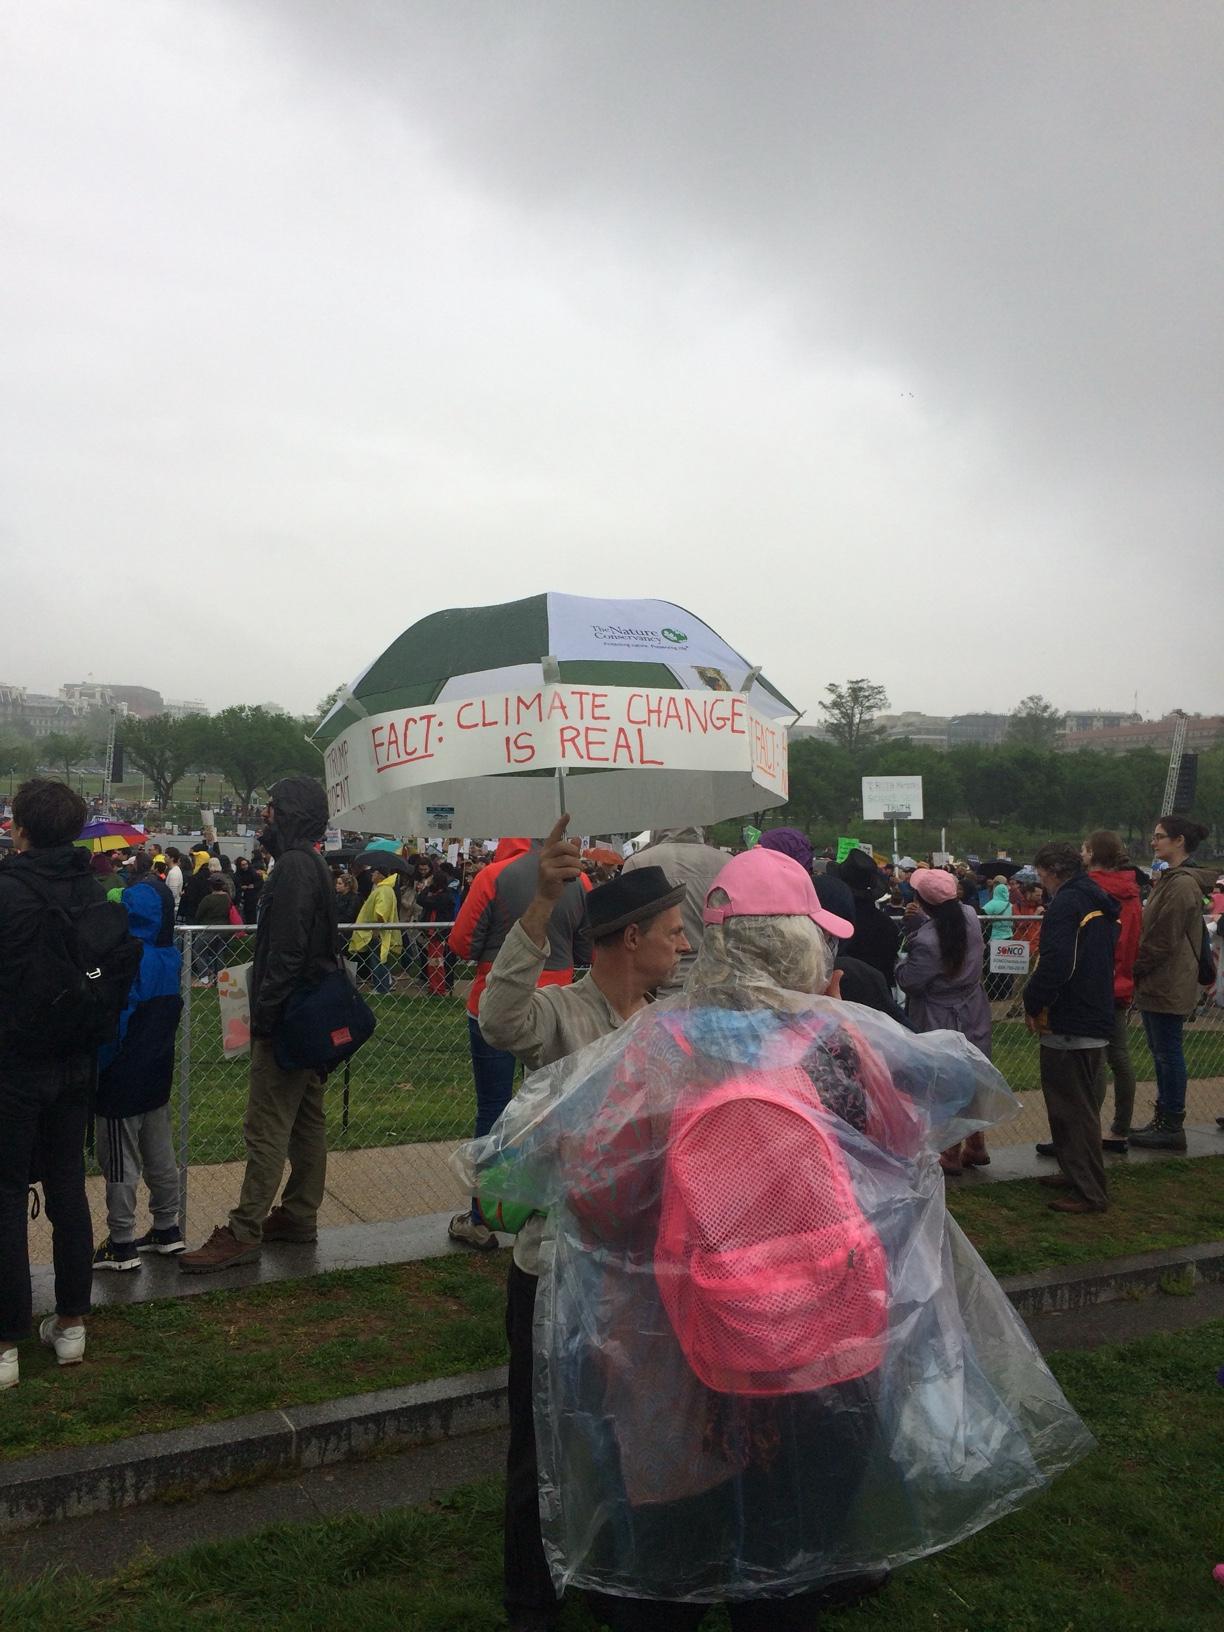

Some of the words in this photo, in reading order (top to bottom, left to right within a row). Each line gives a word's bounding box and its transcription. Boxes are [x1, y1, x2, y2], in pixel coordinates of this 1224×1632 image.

[592, 625, 609, 633] The
[608, 625, 659, 637] Nature
[594, 632, 661, 644] Conservancy
[371, 714, 444, 766] FACT:
[456, 691, 610, 730] CLIMATE
[627, 693, 746, 734] CHANGE
[505, 732, 535, 763] IS
[560, 726, 664, 765] REAL
[997, 945, 1024, 956] SONCO
